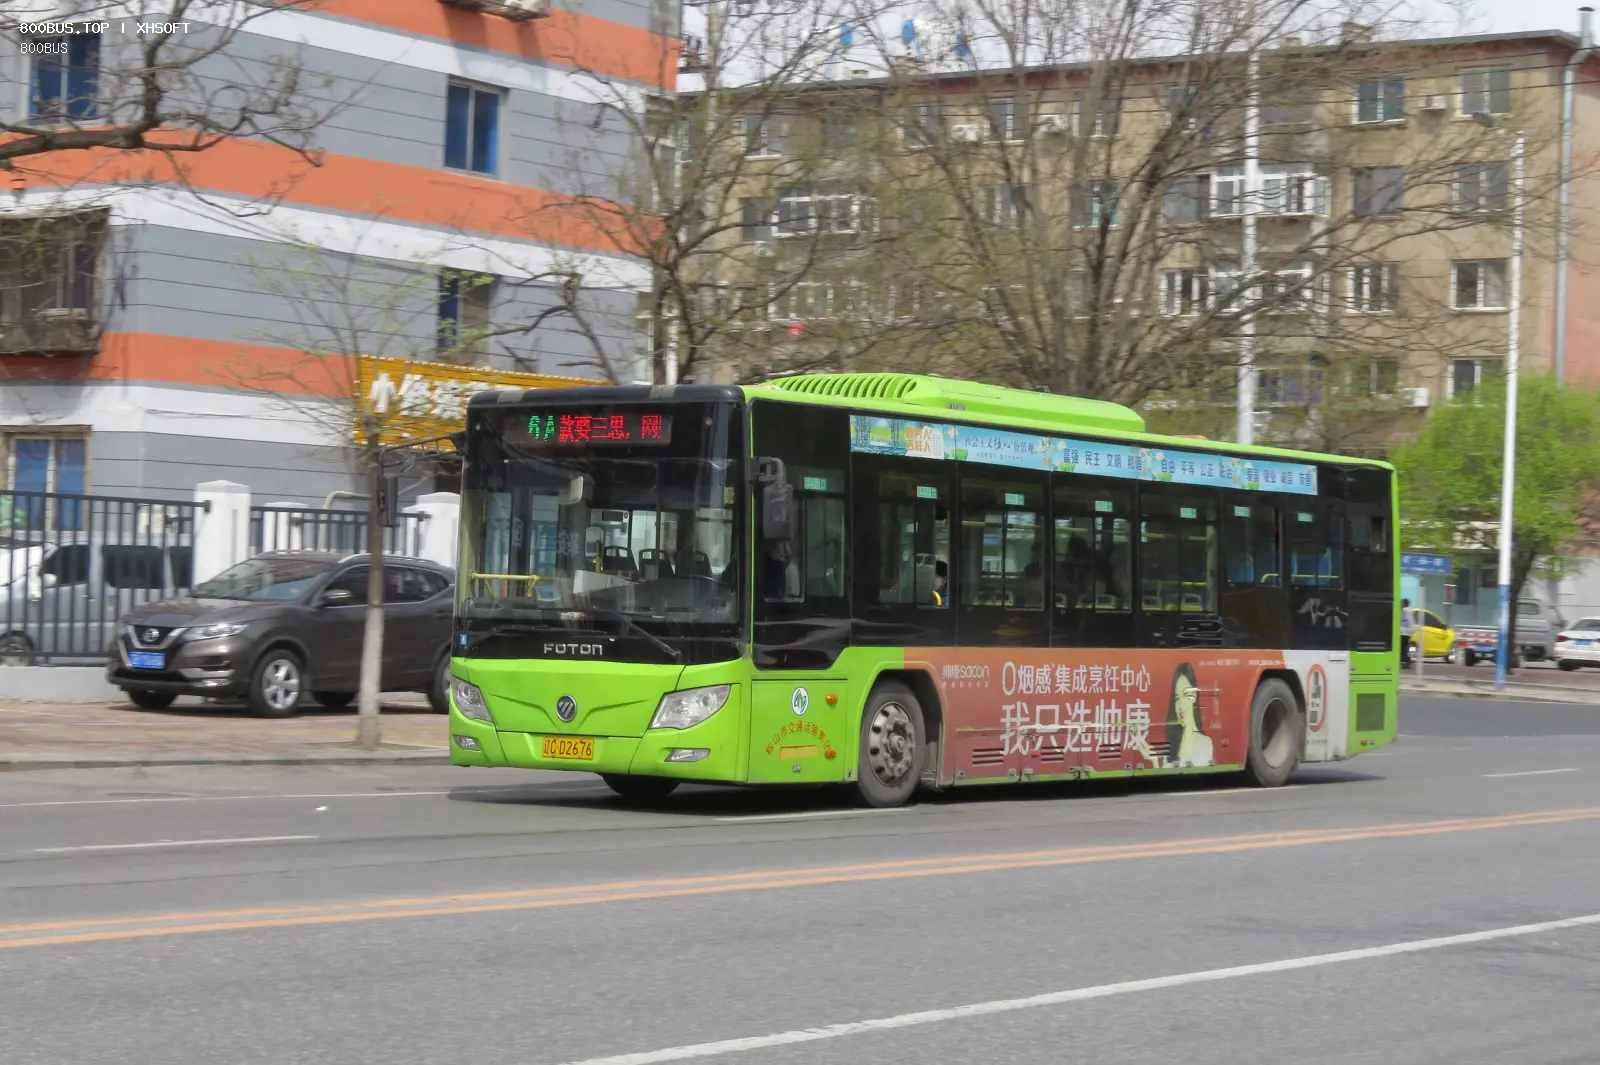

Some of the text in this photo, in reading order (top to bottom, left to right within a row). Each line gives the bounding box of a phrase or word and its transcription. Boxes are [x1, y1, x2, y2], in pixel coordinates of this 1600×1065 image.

[1085, 450, 1100, 466] 民主
[543, 643, 603, 656] FOTON
[1000, 698, 1151, 756] 我只选帅康
